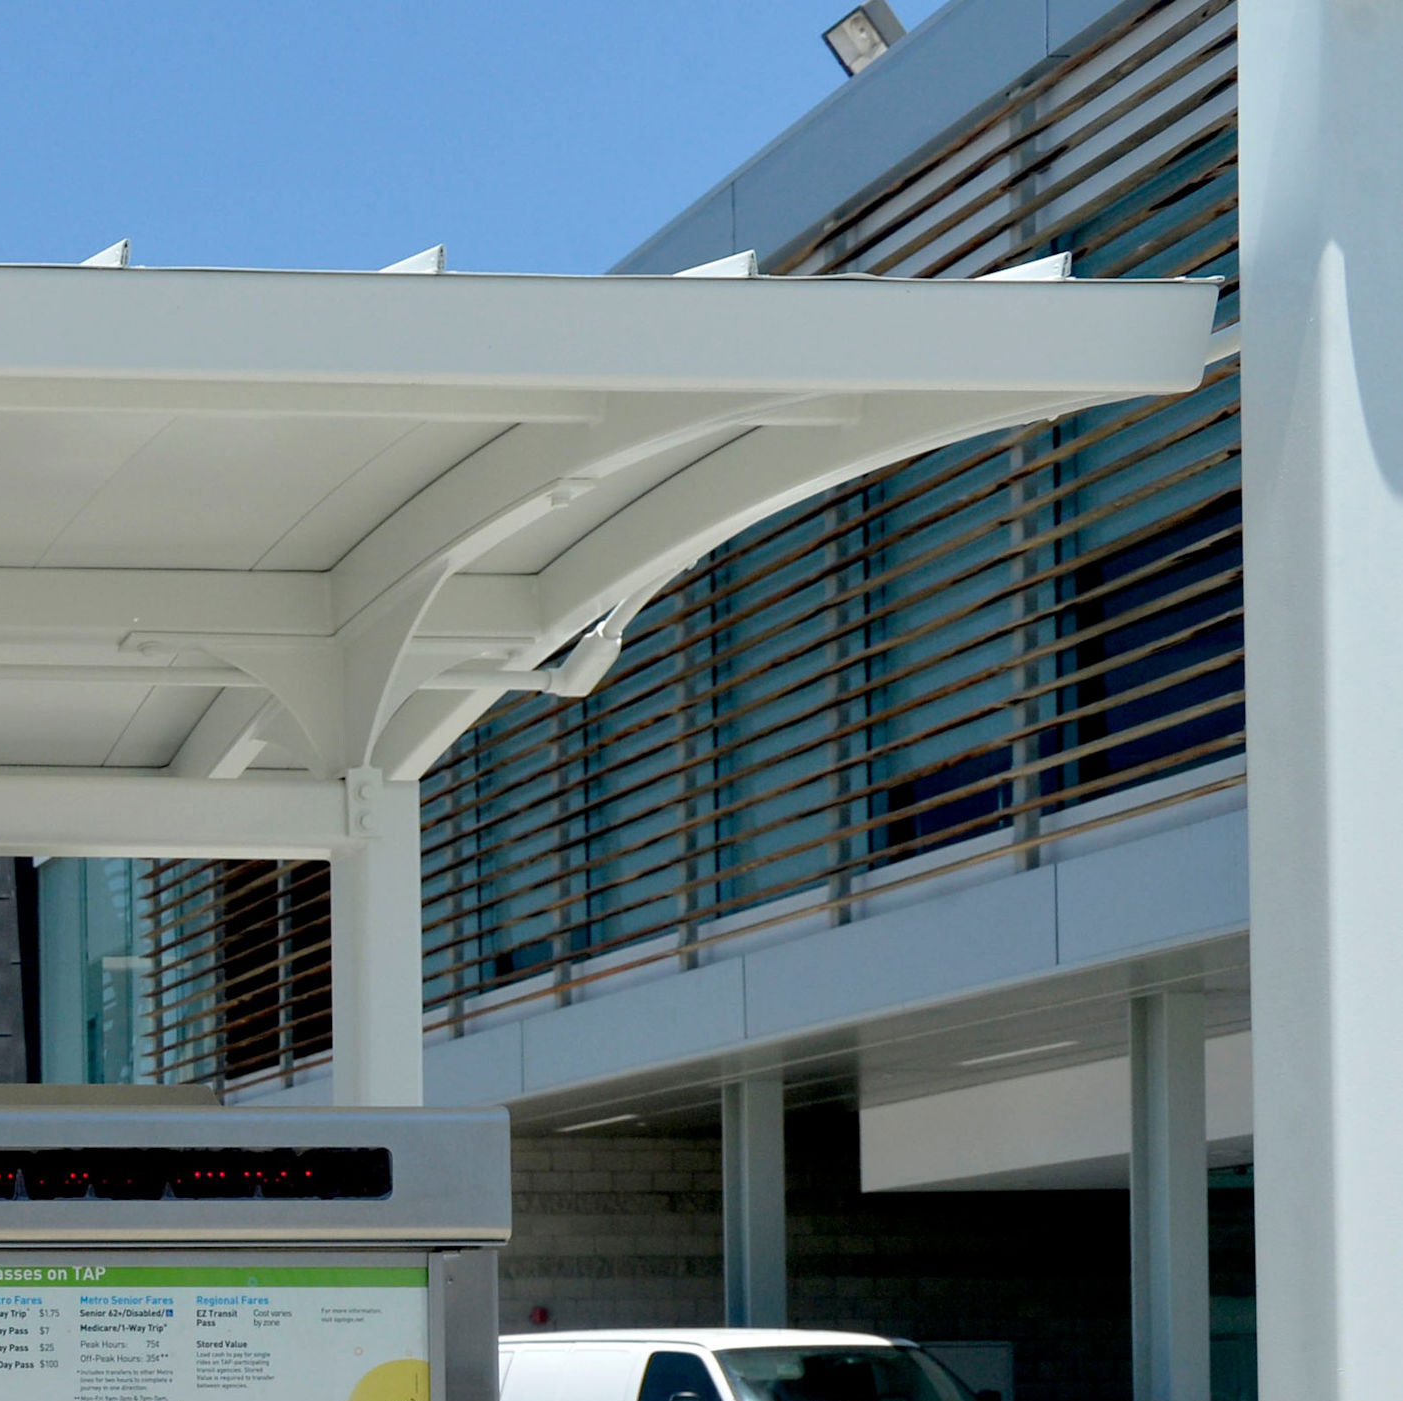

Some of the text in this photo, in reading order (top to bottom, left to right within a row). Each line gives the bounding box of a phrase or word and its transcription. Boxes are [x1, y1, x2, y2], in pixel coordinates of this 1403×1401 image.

[48, 1268, 68, 1281] on
[72, 1267, 106, 1281] TAP
[14, 1296, 43, 1305] Fares
[39, 1309, 60, 1319] $1.75
[9, 1327, 29, 1336] Pass
[40, 1326, 50, 1336] $7
[9, 1344, 29, 1352] Pass
[39, 1343, 55, 1353] $25
[15, 1361, 35, 1369] Pass
[39, 1360, 59, 1370] $100
